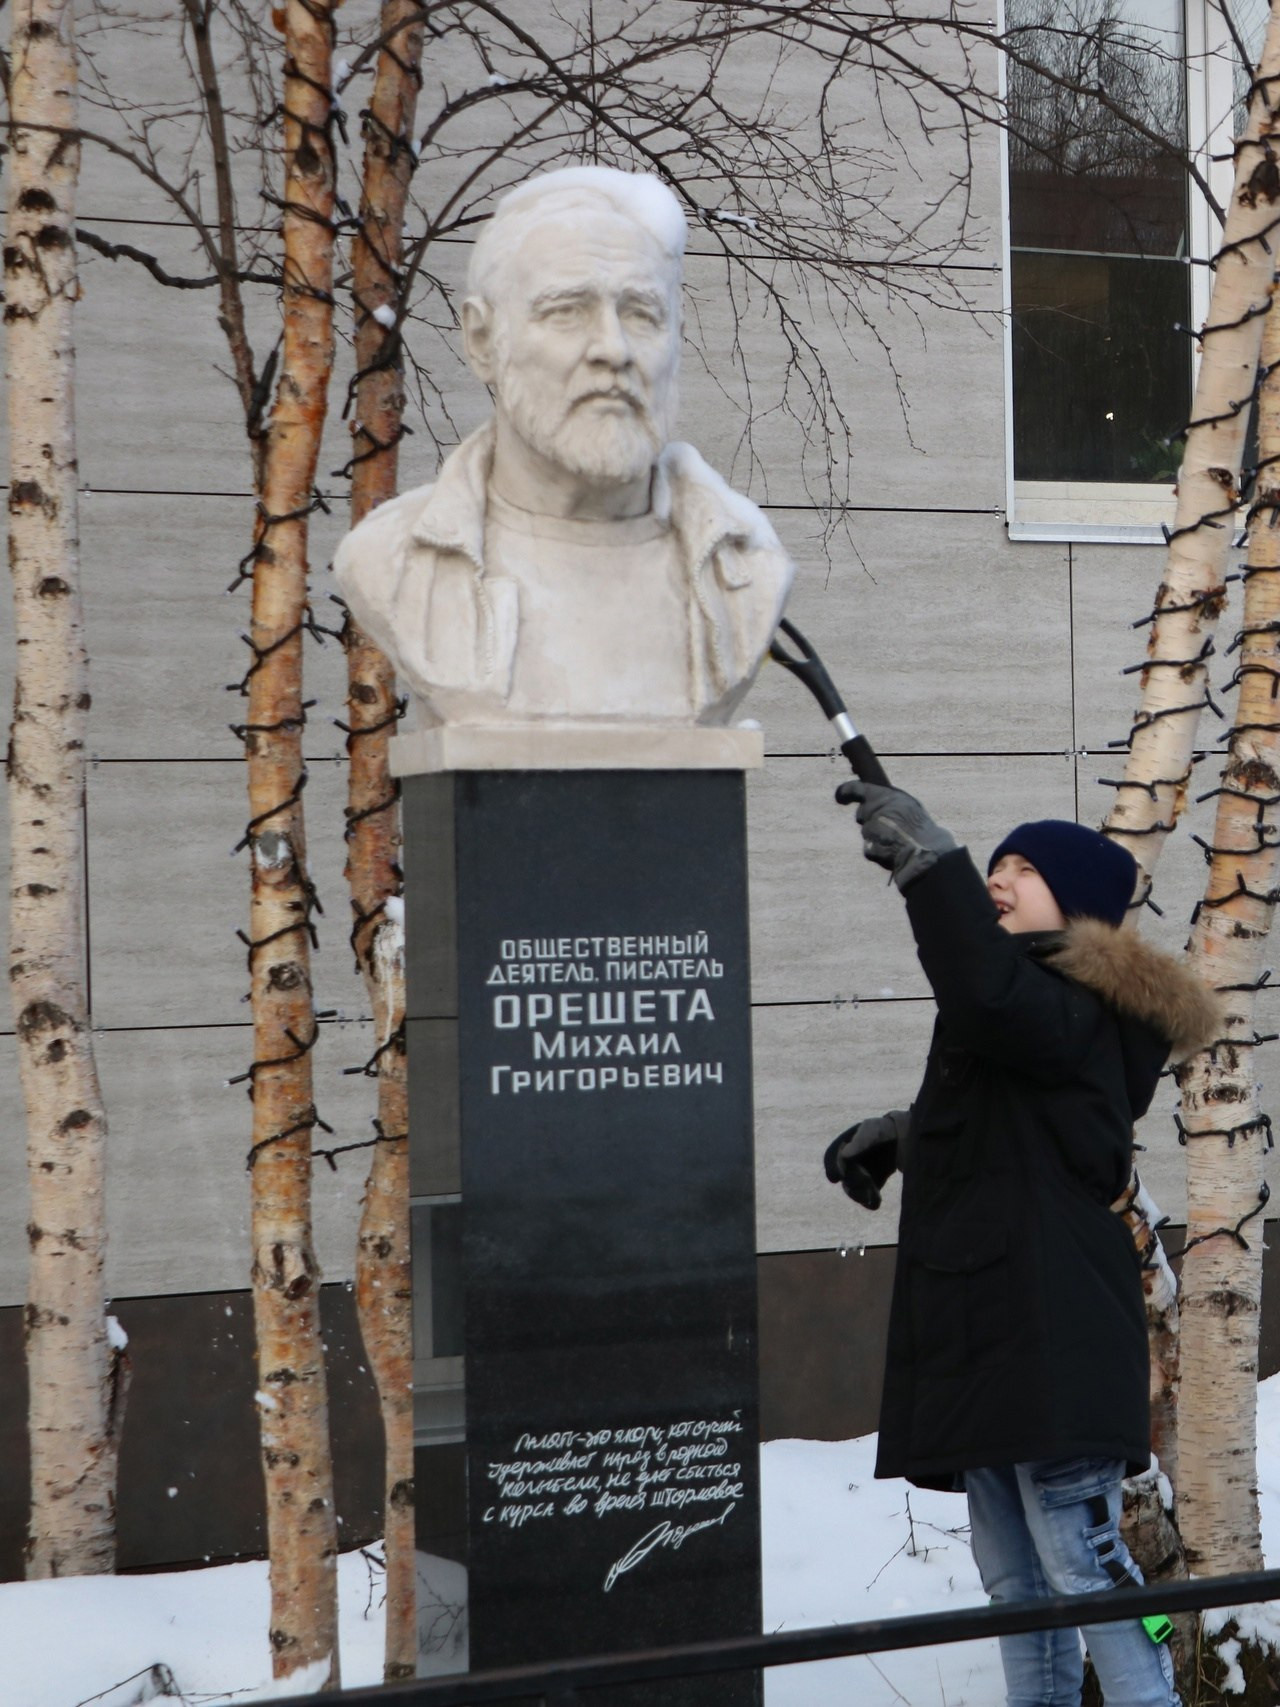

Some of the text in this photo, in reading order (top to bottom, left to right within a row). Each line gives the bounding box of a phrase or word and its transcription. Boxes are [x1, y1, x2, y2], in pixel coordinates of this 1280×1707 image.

[501, 930, 709, 960] ОБЩЕСТВЕННЫЙ
[606, 958, 724, 981] ПИСАТЕЛЬ
[493, 988, 715, 1029] ОРЕШЕТА
[603, 1449, 651, 1472] народ
[656, 1442, 668, 1461] в
[606, 1472, 631, 1488] не
[676, 1463, 741, 1479] сбиться
[563, 1492, 588, 1516] во
